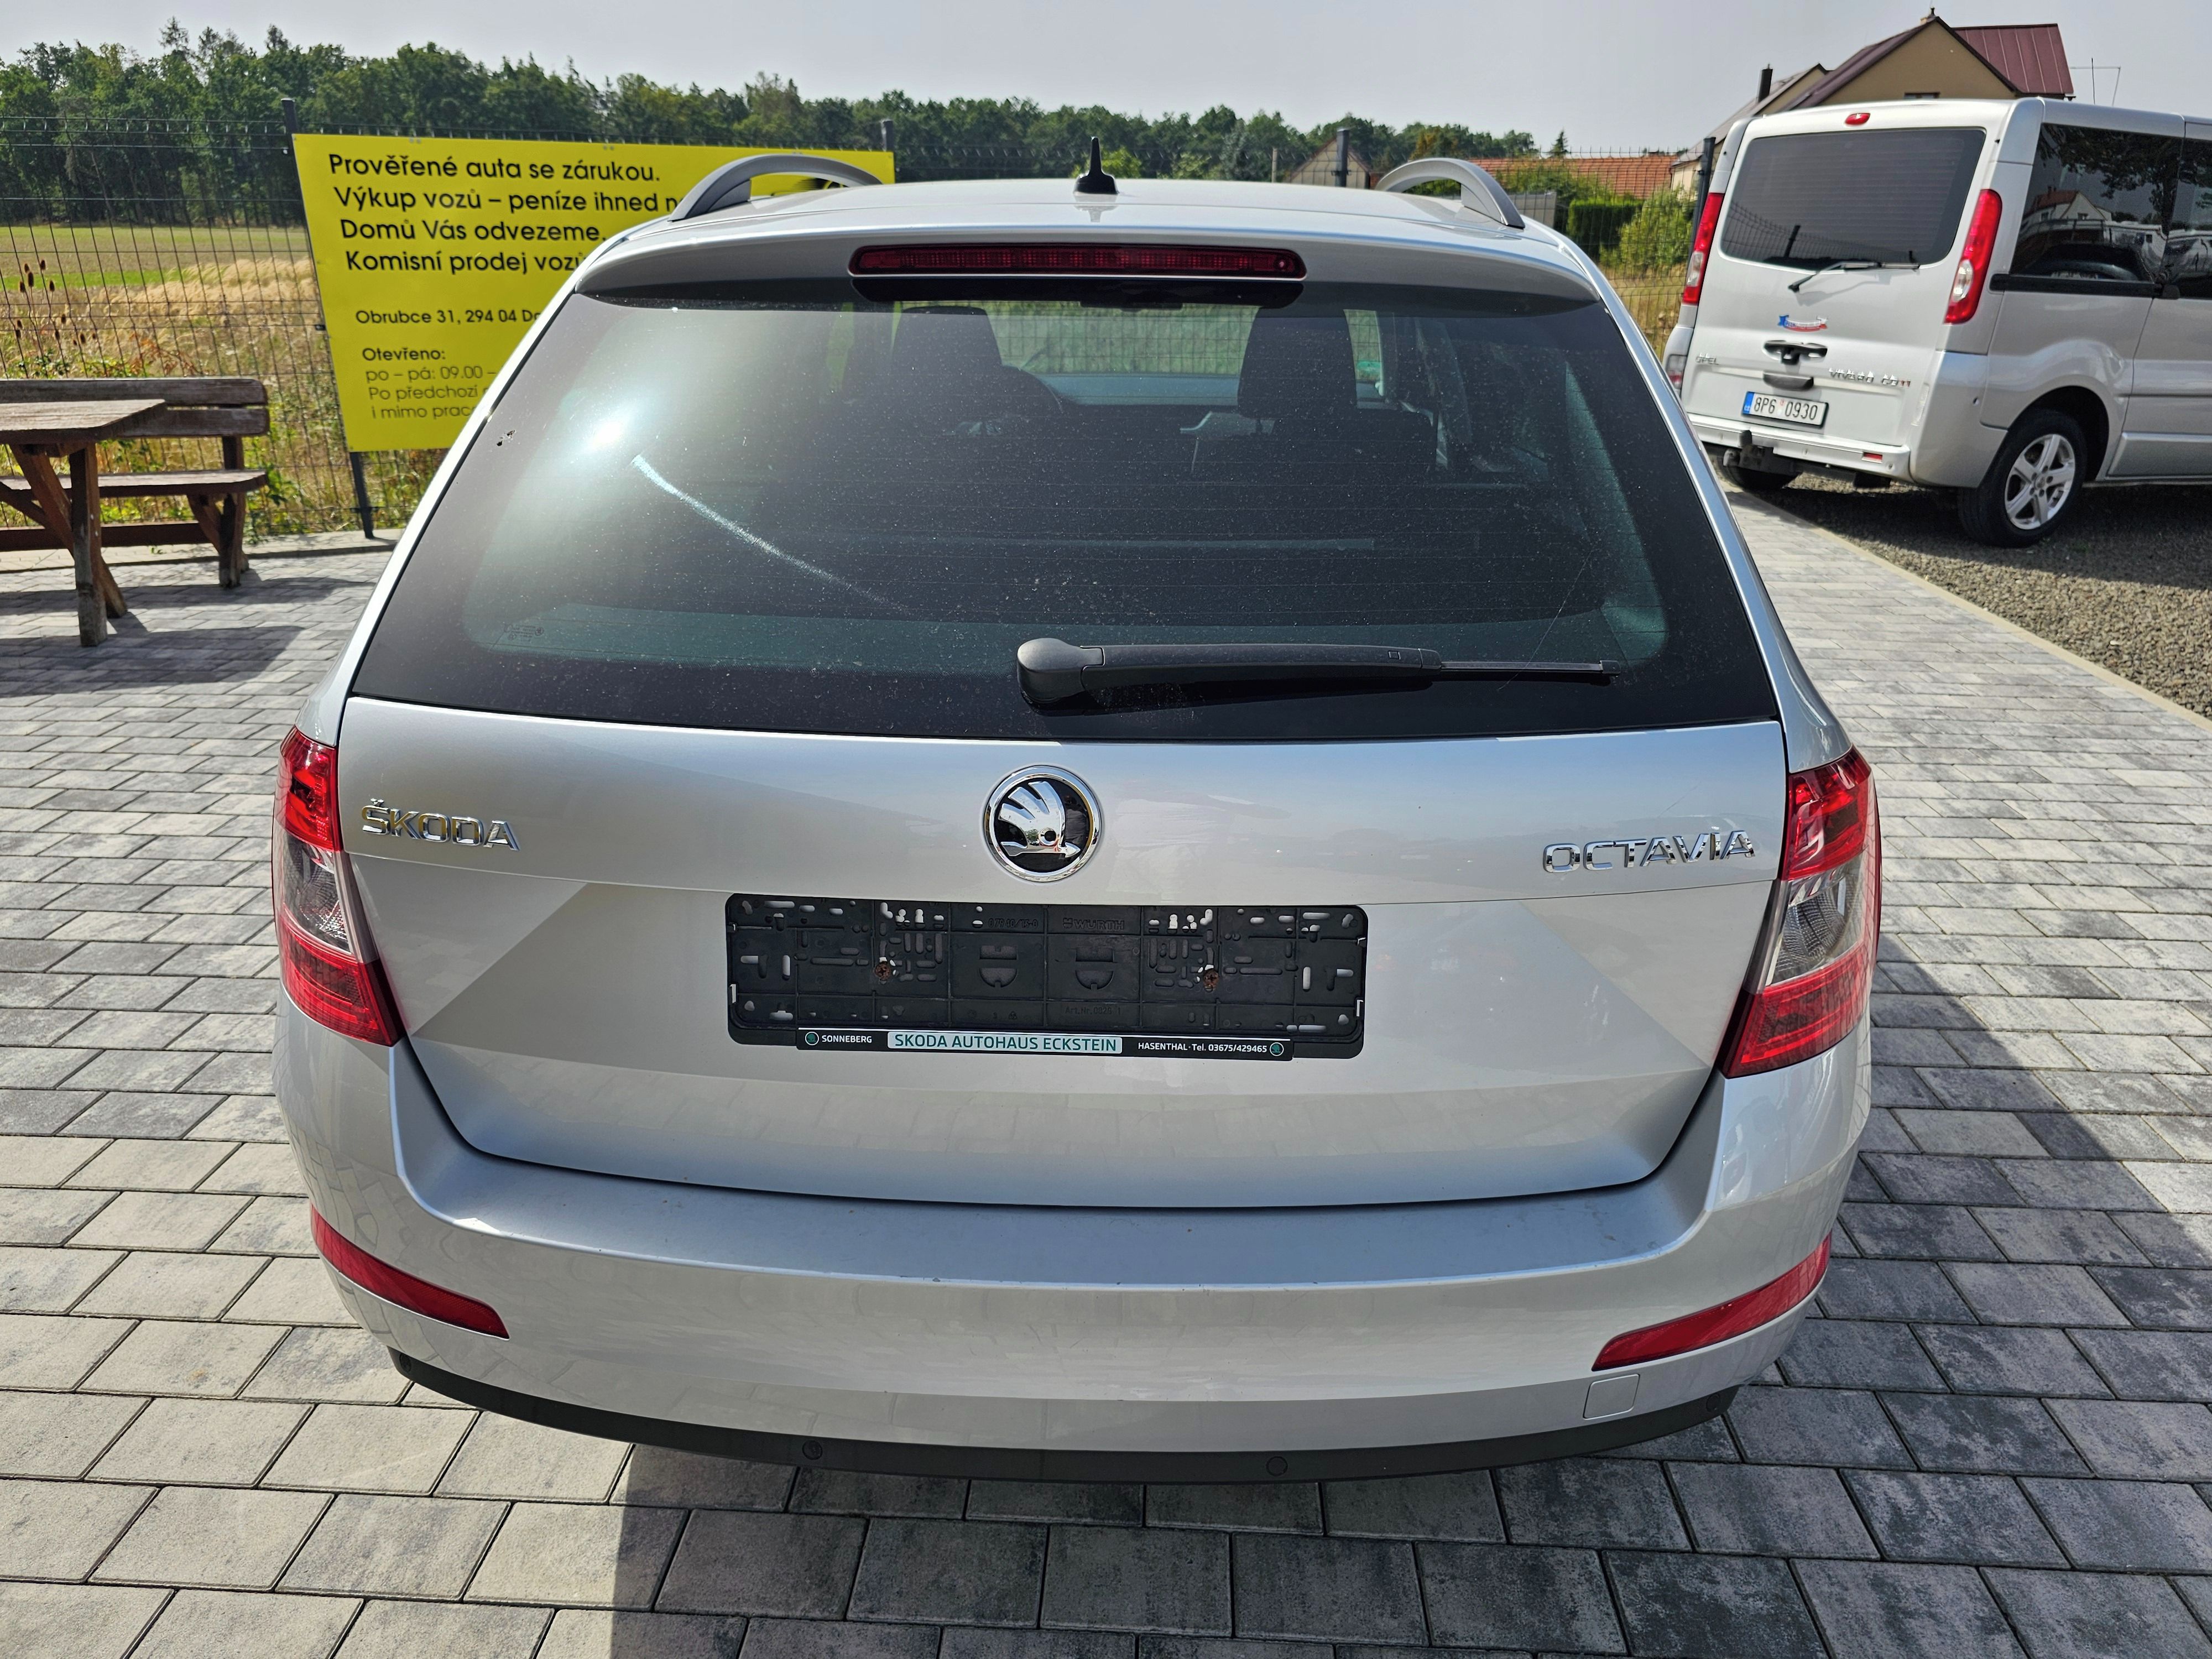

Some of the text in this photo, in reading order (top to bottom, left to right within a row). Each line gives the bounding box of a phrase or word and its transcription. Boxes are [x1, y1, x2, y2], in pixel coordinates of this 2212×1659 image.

[328, 153, 660, 181] Prověřené auta se zárukou.
[333, 186, 416, 212] Výkup
[424, 188, 482, 210] vozů
[509, 190, 587, 213] peníze
[594, 192, 659, 212] ihned
[665, 197, 684, 212] n
[340, 218, 416, 239] Domů
[421, 219, 467, 240] Vás
[346, 251, 442, 271] Komisní
[450, 252, 528, 275] prodej
[356, 310, 432, 324] Obrubce
[437, 310, 462, 325] 31,
[466, 310, 494, 324] 294
[498, 309, 518, 322] 04
[362, 347, 446, 361] Otevřeno:
[1695, 352, 1719, 366] OPEL
[366, 370, 390, 383] po
[408, 367, 436, 383] pá:
[440, 365, 483, 380] 09.00
[368, 387, 391, 400] Po
[396, 384, 479, 402] předchozí
[380, 406, 428, 419] mimo
[1754, 395, 1777, 415] 8P6
[1785, 400, 1819, 421] 0930
[361, 797, 520, 852] ŠKODA
[1542, 830, 1756, 873] OCTAVIA
[821, 1034, 873, 1044] SONNEBERG
[894, 1034, 1117, 1051] SKODA AUTOHAUS ECKSTEIN
[1208, 1044, 1267, 1053] 03675/429465
